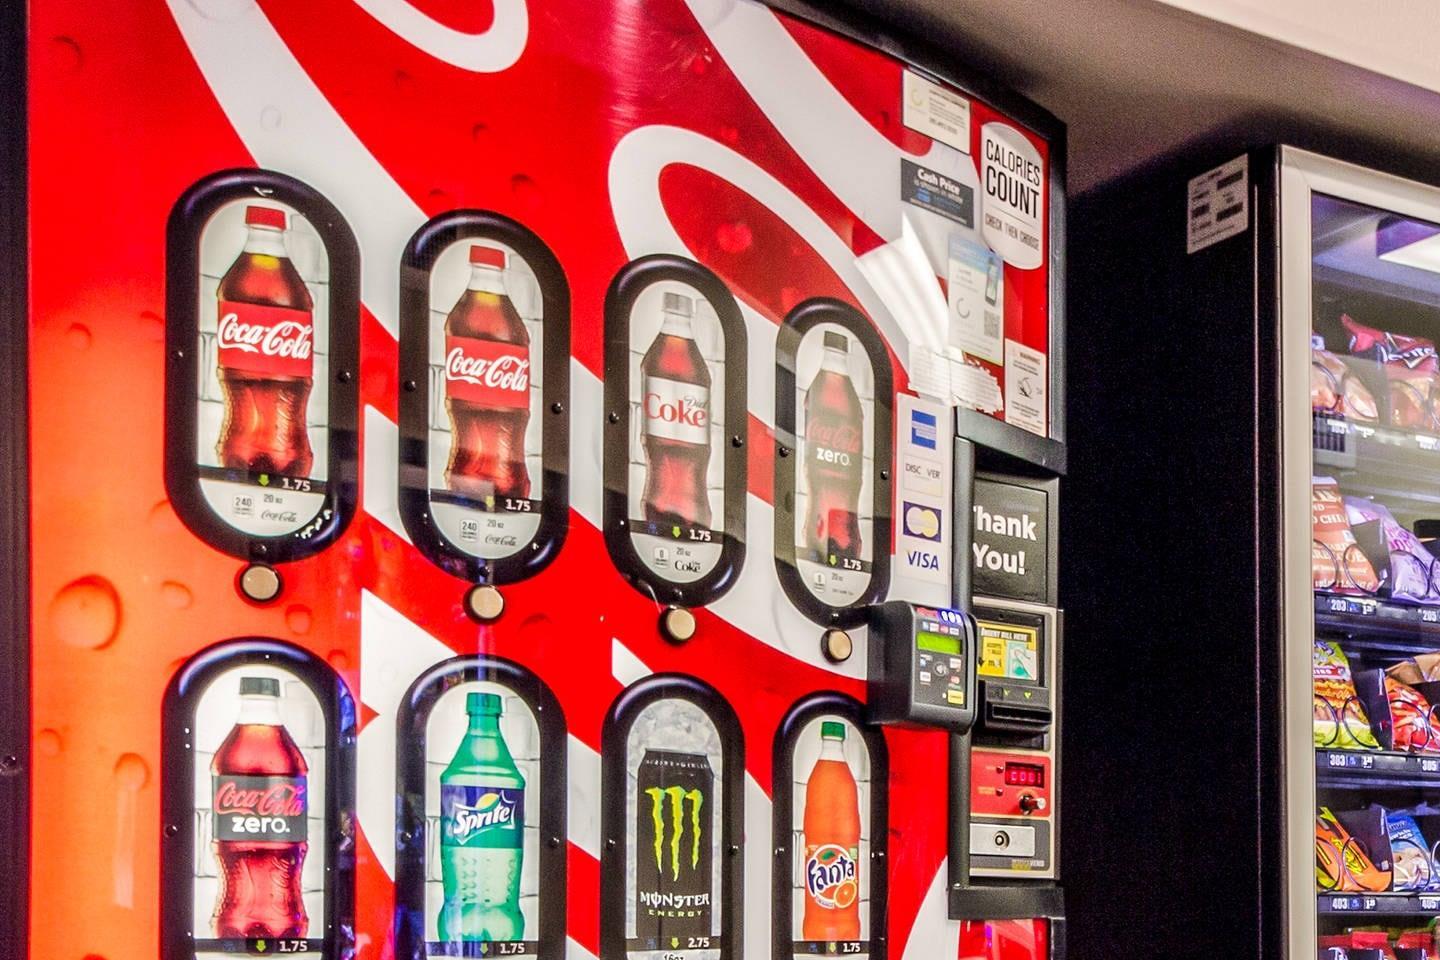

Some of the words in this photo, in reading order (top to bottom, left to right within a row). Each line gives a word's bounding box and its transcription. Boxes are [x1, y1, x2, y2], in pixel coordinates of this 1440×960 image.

[986, 139, 1040, 186] CALORIES
[918, 168, 938, 185] Cash
[939, 178, 960, 195] Price
[986, 166, 1039, 218] COUNT
[218, 312, 313, 360] Coca-Cola
[446, 347, 529, 392] Coca-Cola
[644, 392, 706, 428] Coke
[282, 477, 312, 492] 1.75
[263, 493, 274, 503] 20
[505, 498, 531, 511] 1.75
[462, 521, 478, 531] 240
[487, 518, 497, 528] 20
[973, 505, 1037, 541] hank
[689, 529, 712, 541] 1.75
[843, 558, 862, 571] 1.75
[906, 550, 939, 571] VISA
[972, 542, 1026, 576] You!
[674, 560, 701, 573] Coke
[1331, 599, 1346, 612] 203
[1422, 609, 1437, 622] 205
[215, 781, 306, 816] Coca-Cola
[453, 807, 510, 836] Sprite
[640, 891, 710, 907] MONSTER
[649, 909, 703, 918] ENERGY
[279, 940, 308, 952] 1.75
[499, 943, 525, 954] 1.75
[688, 937, 710, 949] 2.75
[843, 943, 861, 953] 1.75
